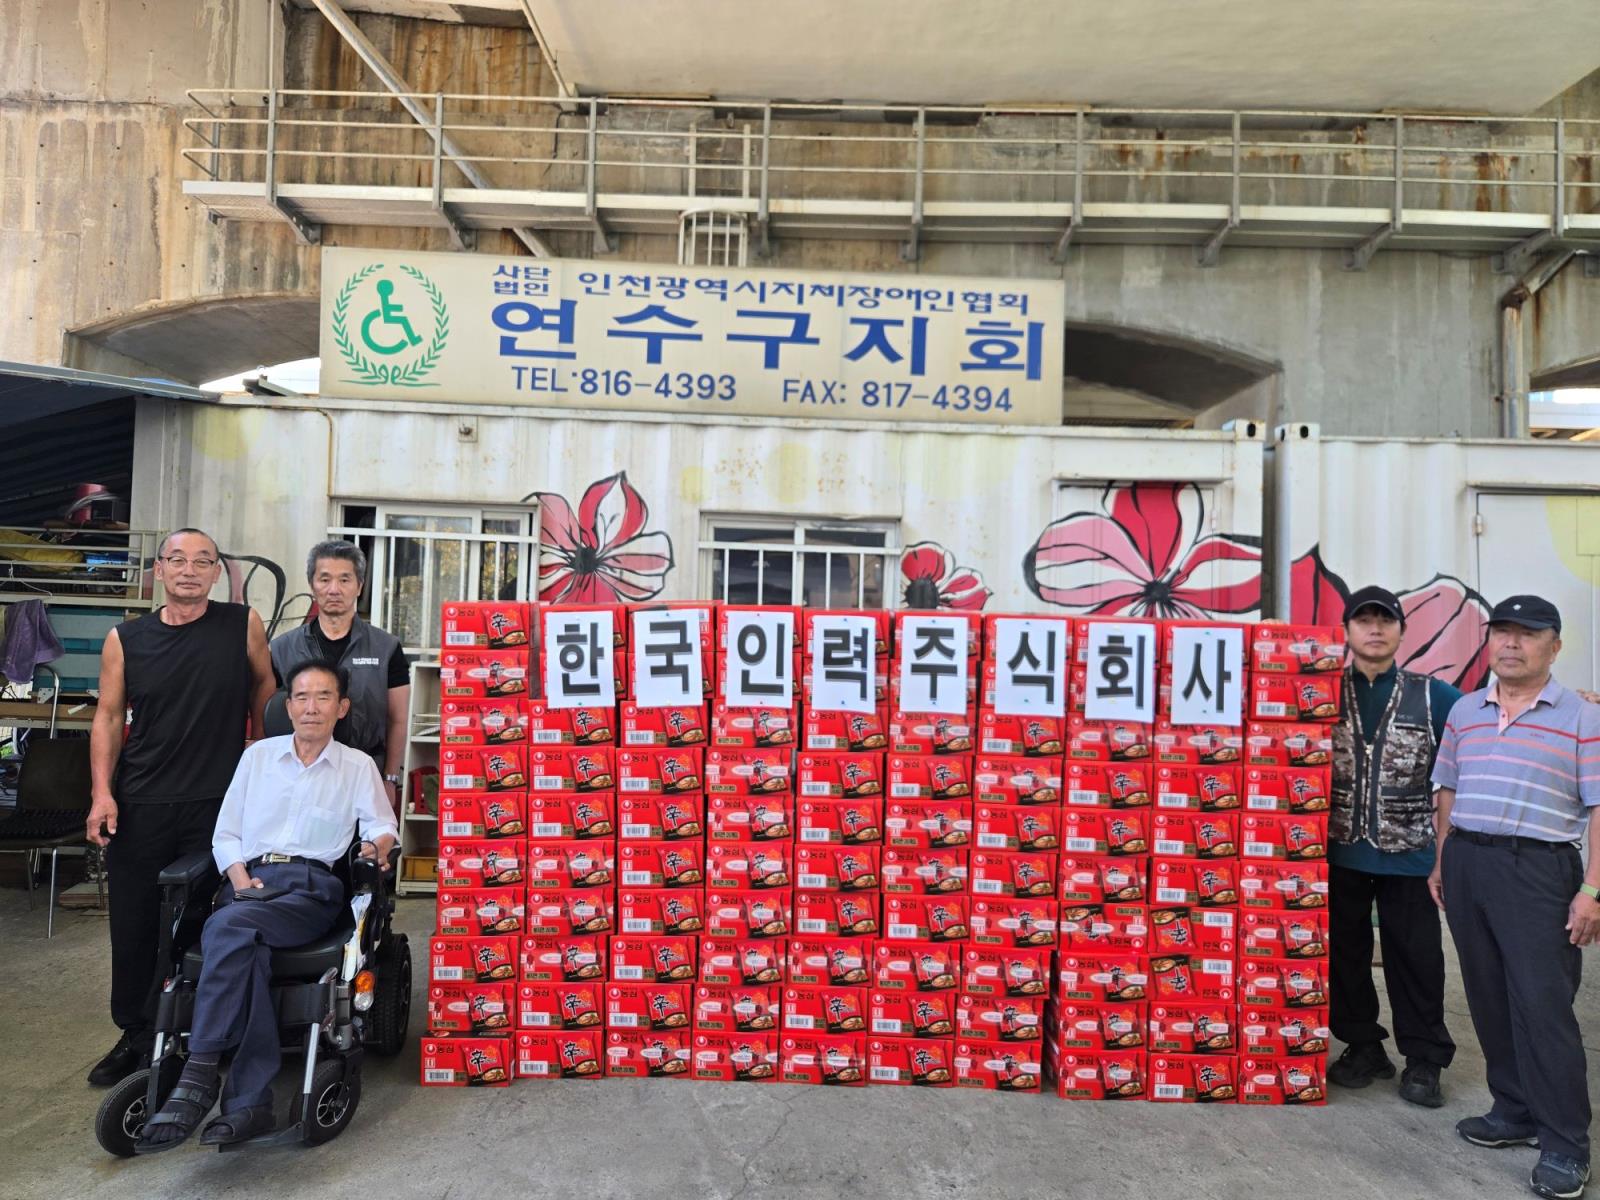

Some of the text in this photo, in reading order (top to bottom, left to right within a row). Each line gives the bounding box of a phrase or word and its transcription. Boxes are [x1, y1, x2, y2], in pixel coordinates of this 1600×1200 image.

[493, 264, 551, 281] 사단
[493, 281, 550, 297] 법인
[491, 298, 1045, 381] 연수구지회
[783, 379, 847, 405] FAX:
[861, 380, 1013, 413] 817-4394
